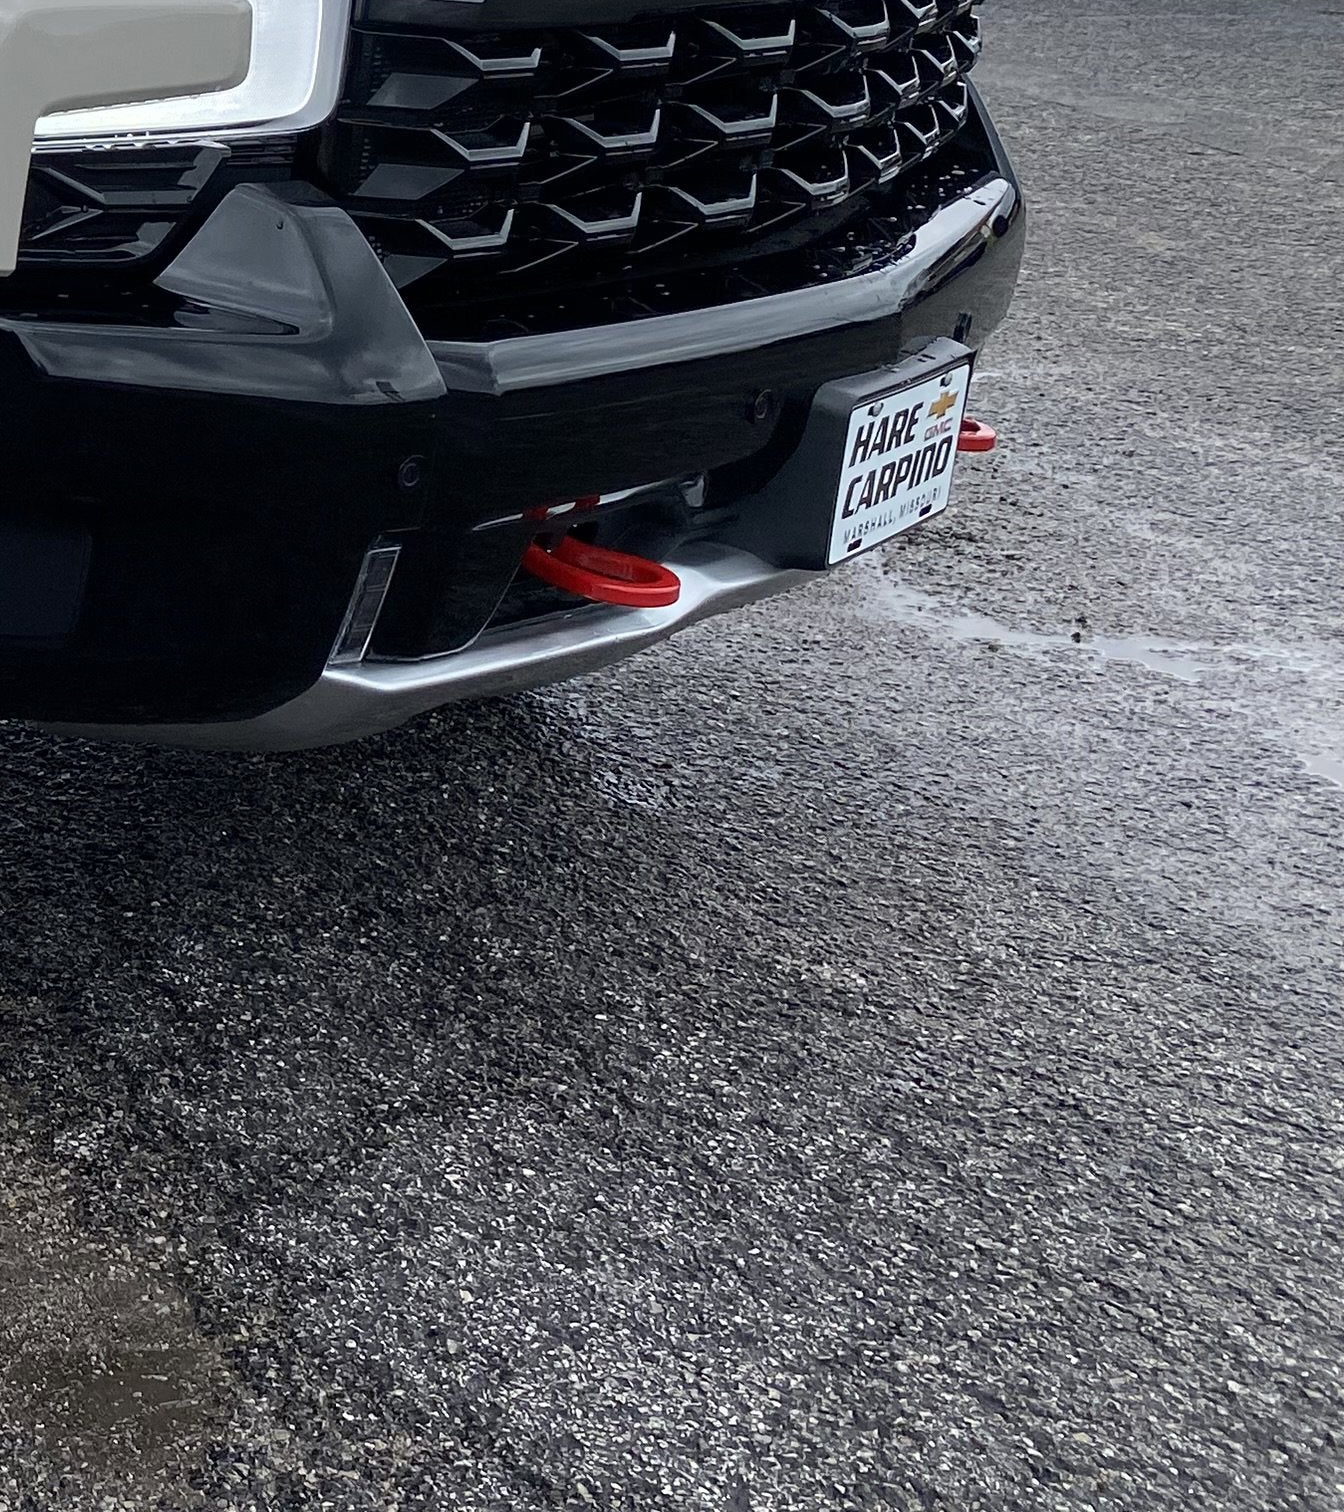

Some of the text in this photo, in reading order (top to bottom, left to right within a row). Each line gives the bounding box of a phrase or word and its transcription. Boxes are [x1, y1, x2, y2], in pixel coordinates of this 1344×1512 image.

[847, 401, 925, 469] HARE
[925, 418, 953, 441] GMC
[841, 435, 953, 519] CARPINO
